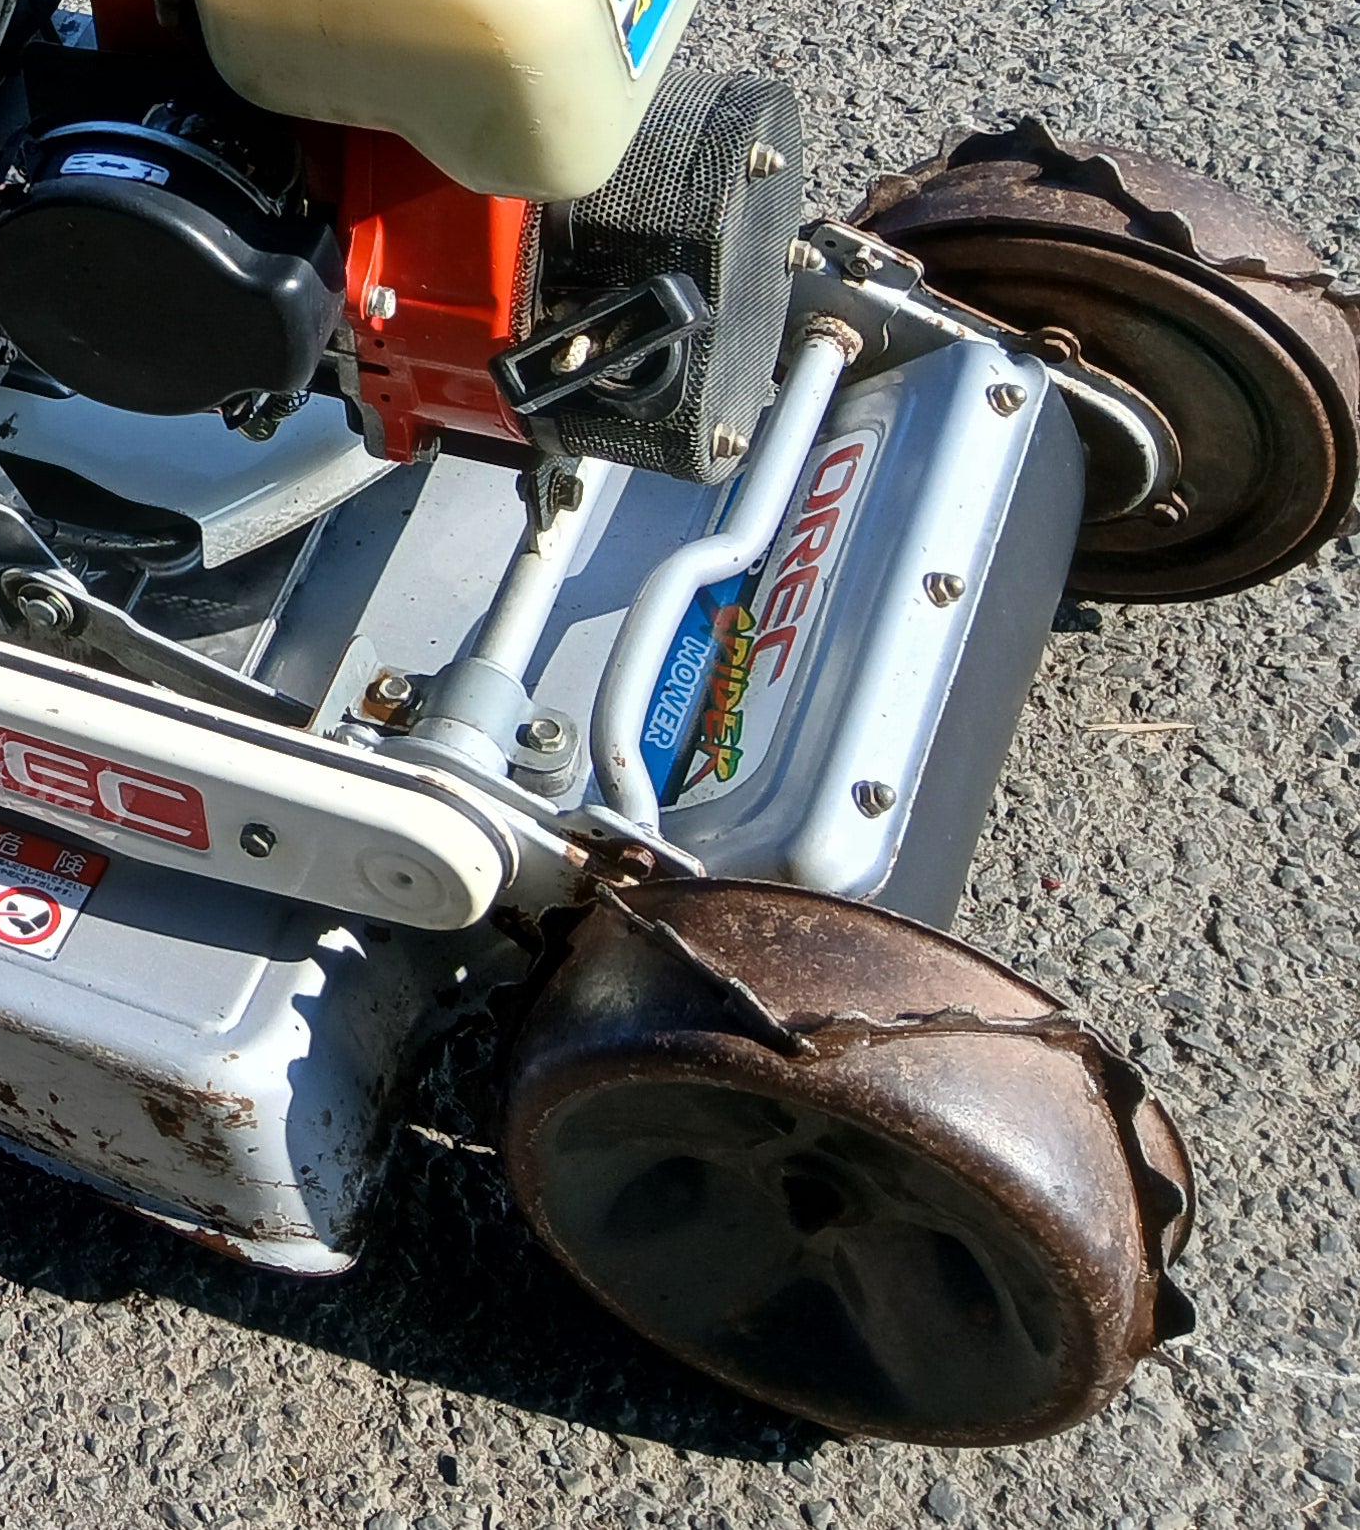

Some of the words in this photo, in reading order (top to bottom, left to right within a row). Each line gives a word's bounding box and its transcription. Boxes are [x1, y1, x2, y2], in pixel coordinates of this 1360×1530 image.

[745, 442, 865, 688] OREC
[644, 635, 711, 751] MOWER
[682, 604, 758, 797] SPIDER
